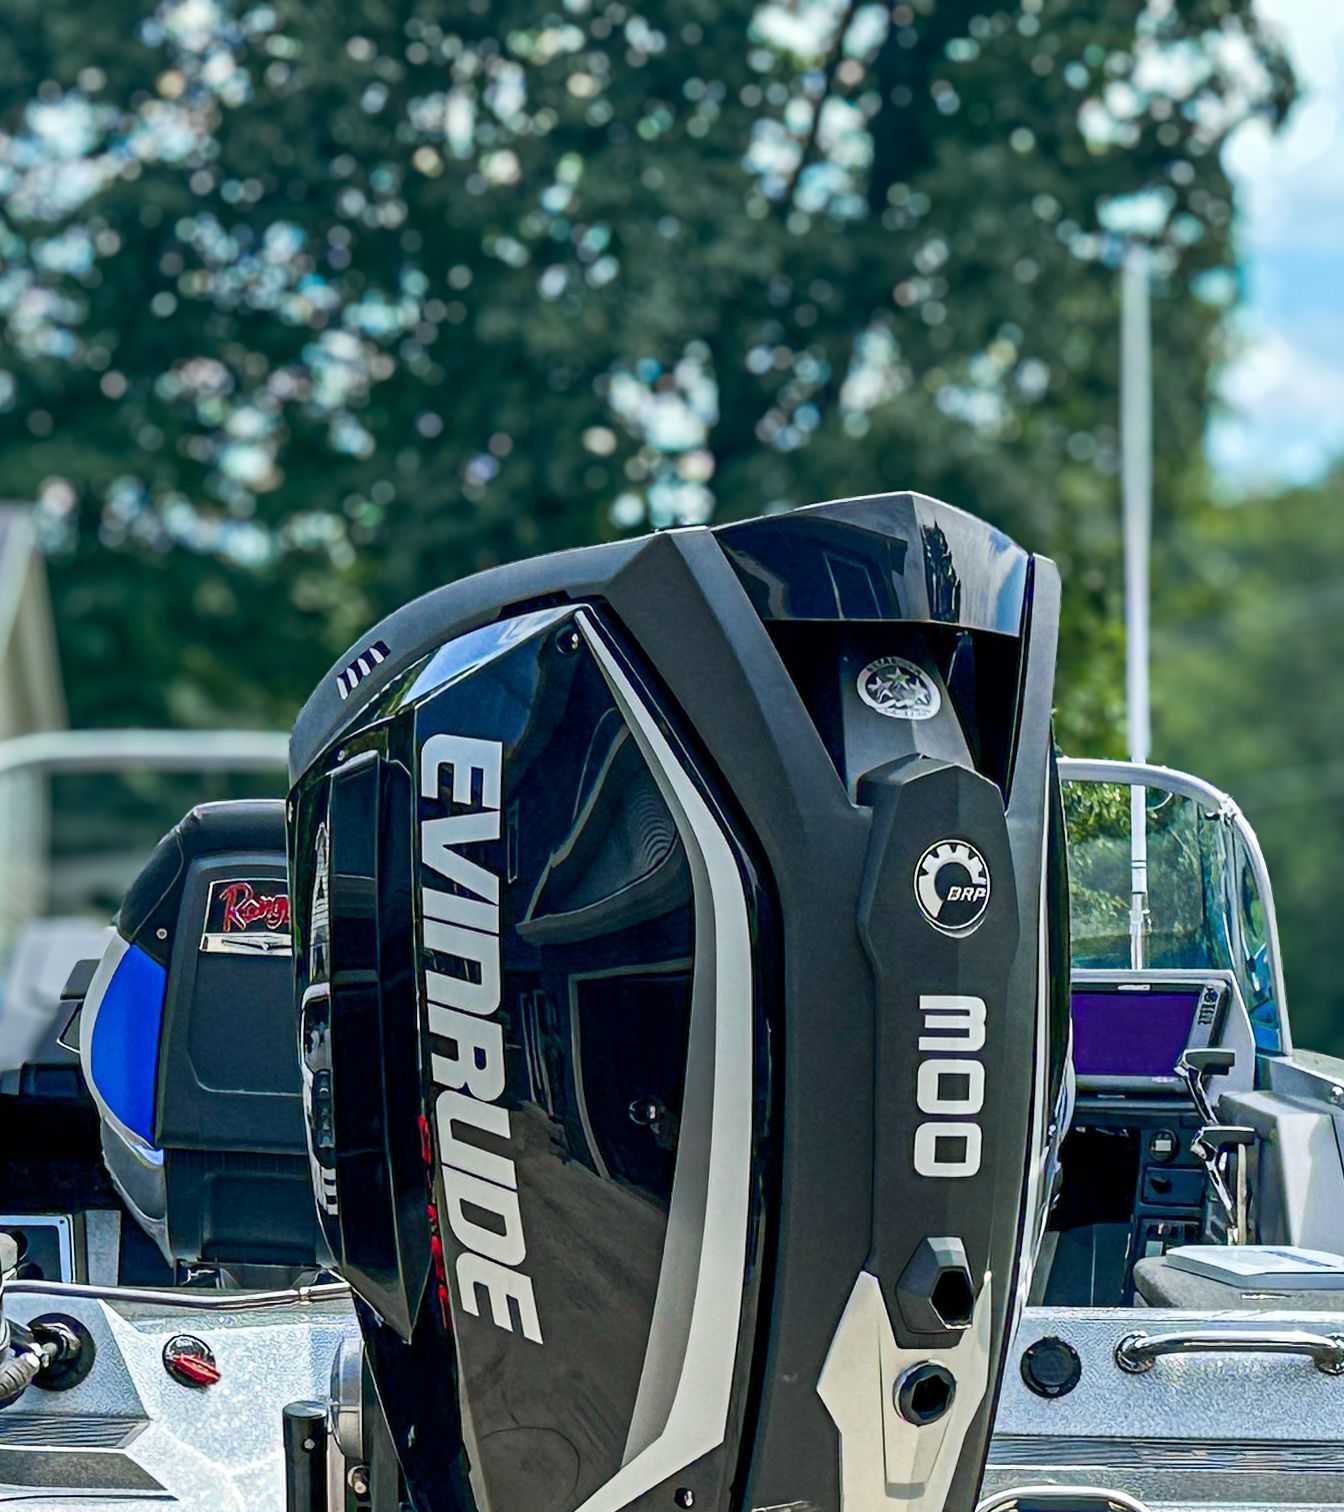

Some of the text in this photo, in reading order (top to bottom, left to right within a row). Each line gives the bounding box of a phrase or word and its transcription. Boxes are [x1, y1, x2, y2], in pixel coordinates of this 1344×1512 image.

[947, 886, 987, 902] BRP
[421, 734, 544, 1344] EVINRUDE
[913, 994, 986, 1178] 300
